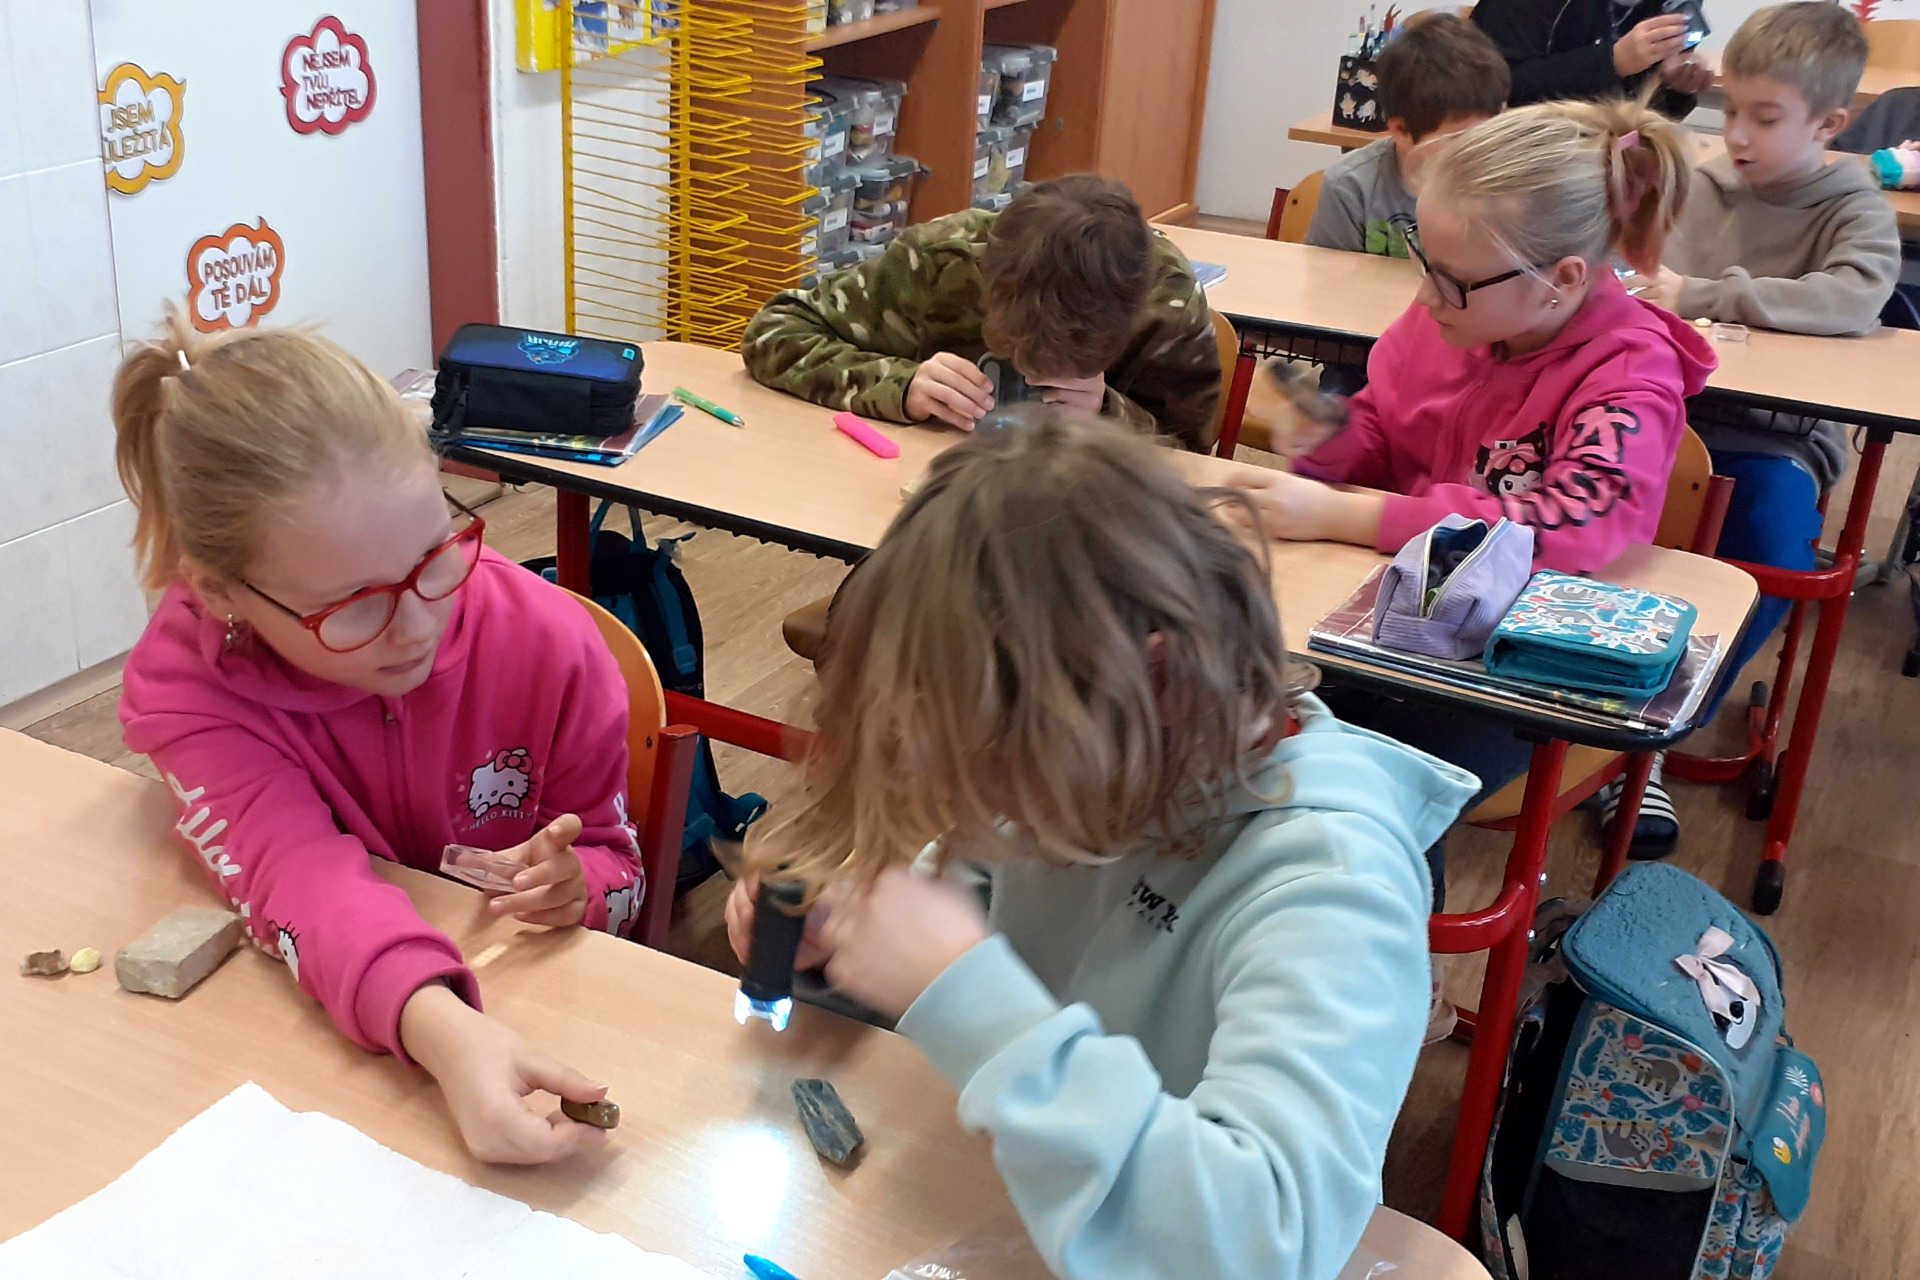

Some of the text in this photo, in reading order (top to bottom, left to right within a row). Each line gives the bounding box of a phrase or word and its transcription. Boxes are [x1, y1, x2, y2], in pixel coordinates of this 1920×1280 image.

[302, 49, 351, 72] NEJSEM
[107, 100, 156, 133] JSEM
[101, 120, 172, 164] ŮLEŽITÁ
[204, 245, 275, 285] POSOUVÁM
[235, 275, 268, 304] DÁL
[468, 811, 498, 832] HELLO
